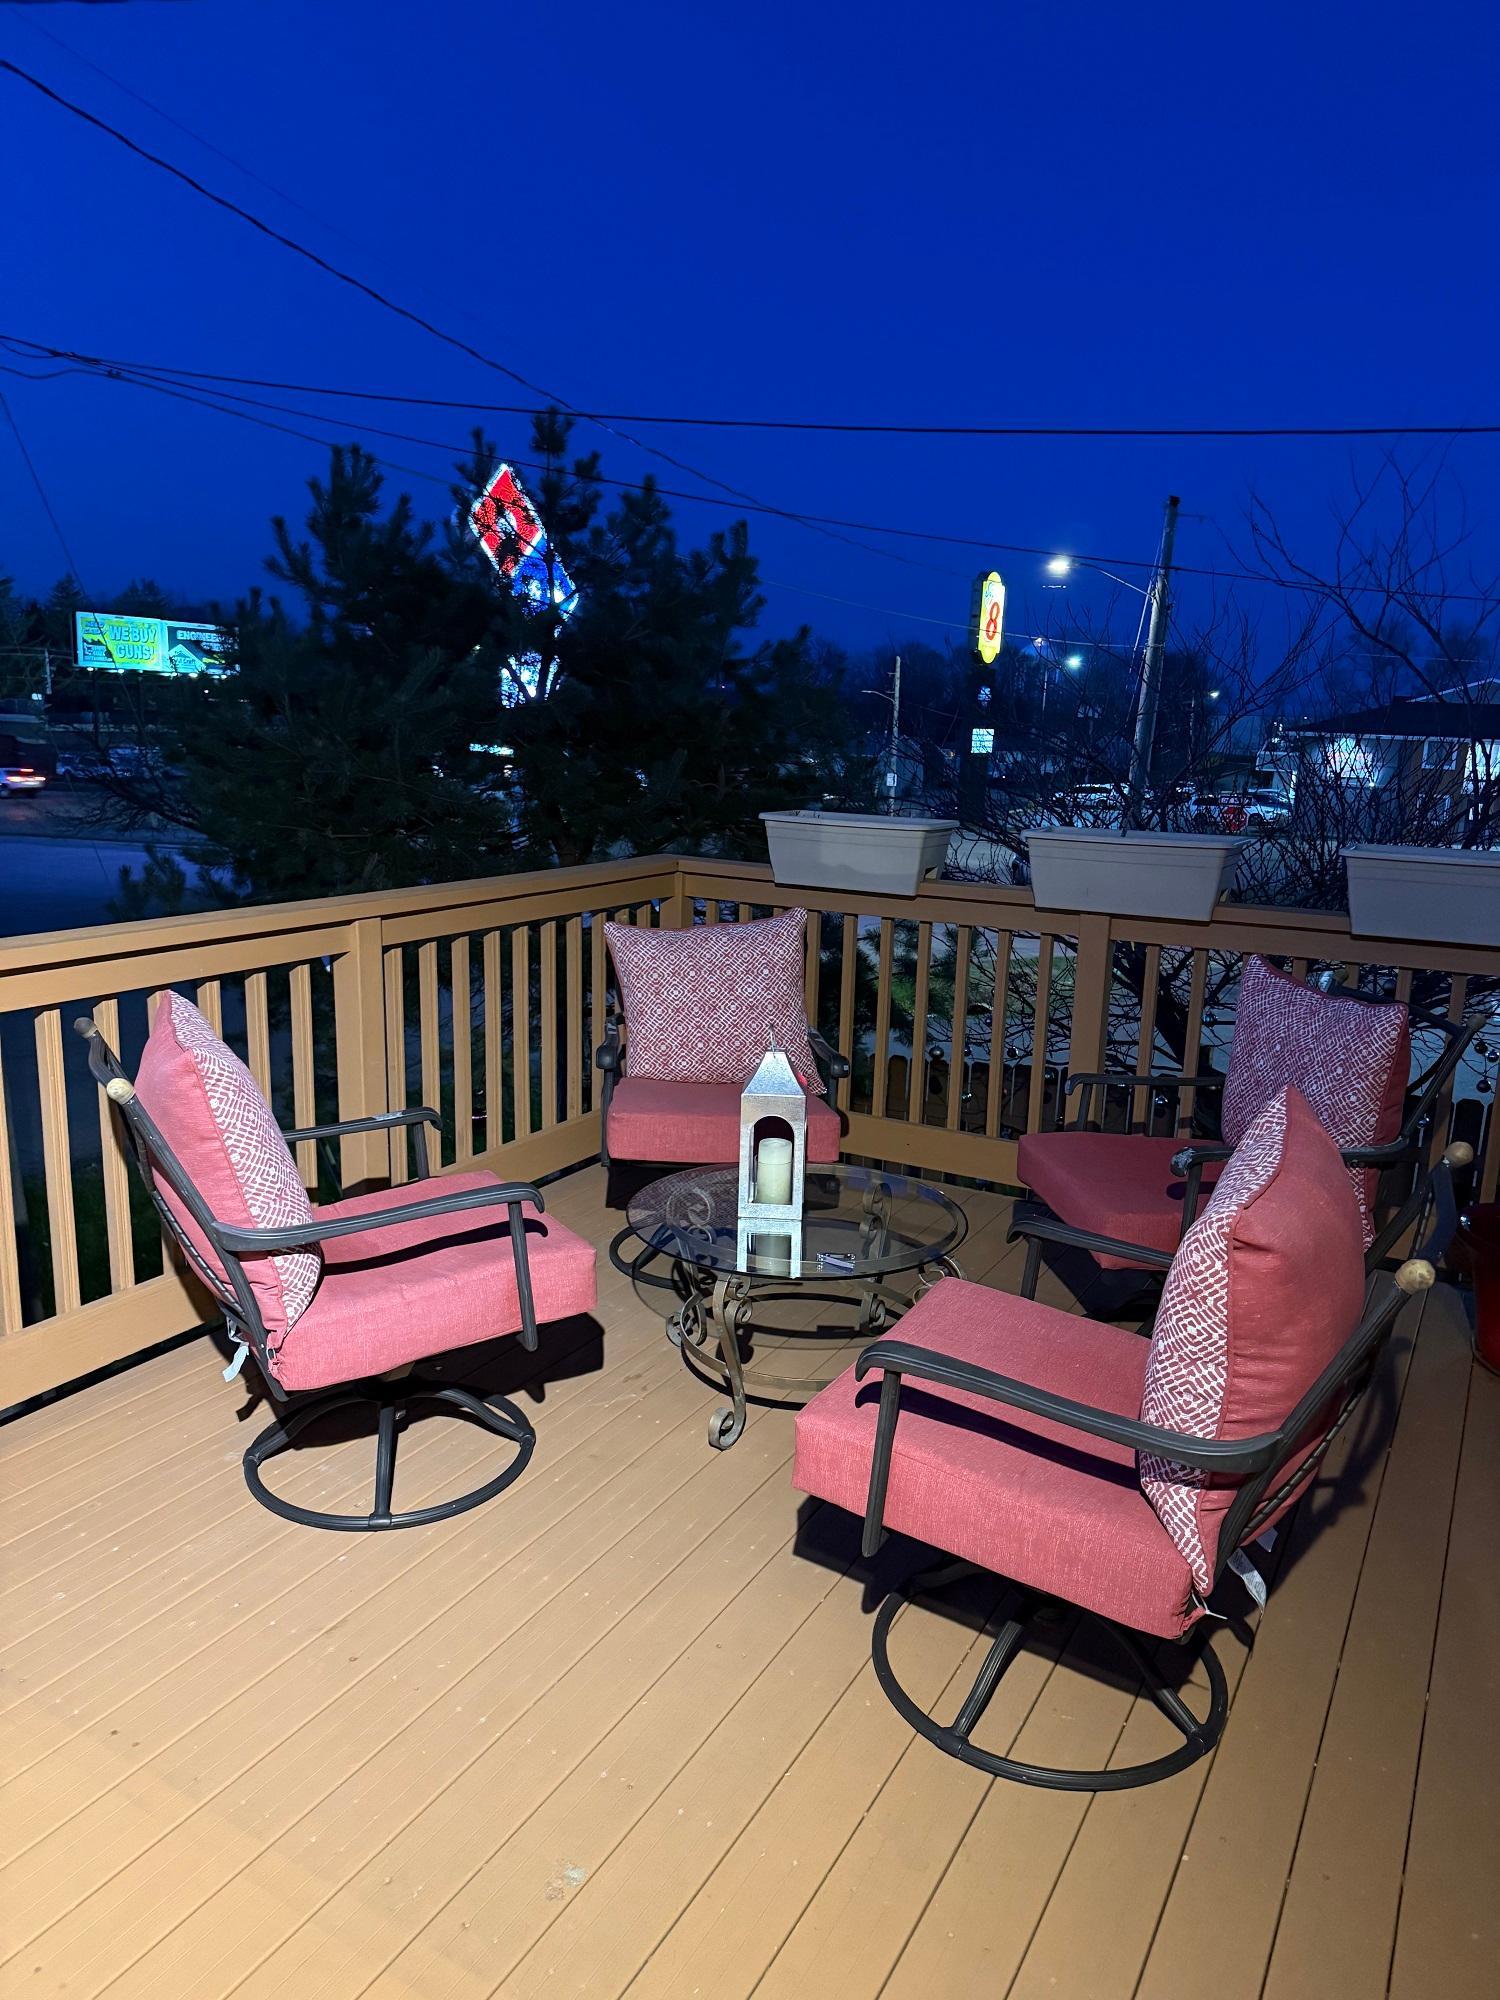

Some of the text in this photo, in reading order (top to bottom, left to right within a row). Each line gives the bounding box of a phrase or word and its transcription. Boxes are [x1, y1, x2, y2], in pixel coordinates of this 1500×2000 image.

[986, 601, 1000, 641] 8
[109, 625, 157, 643] WE BUY
[116, 643, 155, 660] GUNS!
